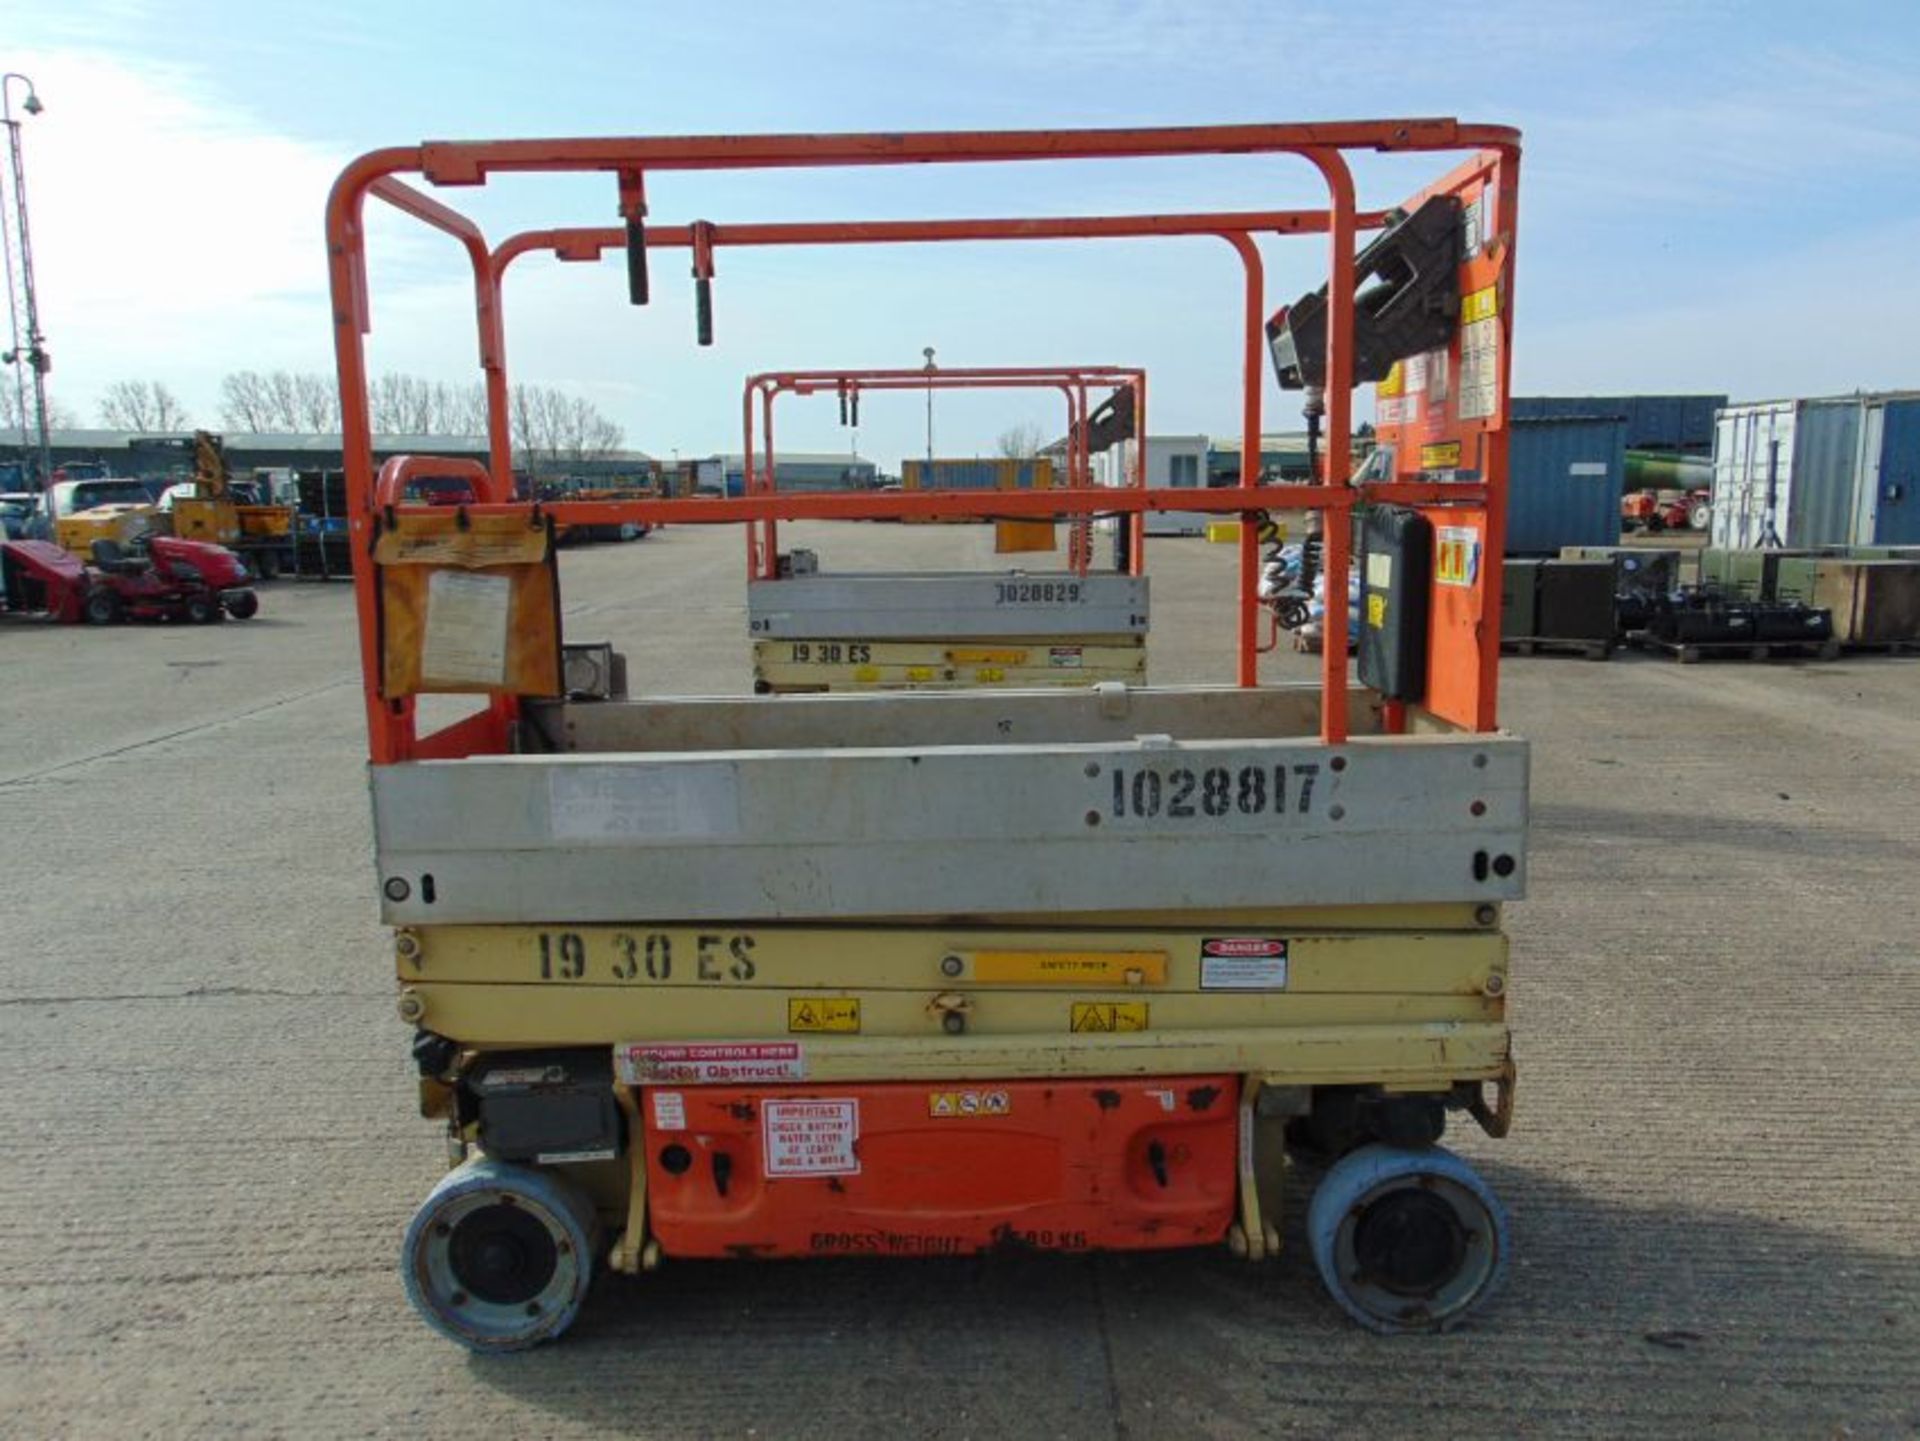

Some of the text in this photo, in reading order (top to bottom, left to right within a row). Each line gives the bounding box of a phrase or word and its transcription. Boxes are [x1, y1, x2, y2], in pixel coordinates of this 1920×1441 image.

[792, 644, 871, 663] 19 30 ES
[1112, 764, 1320, 818] 1028817
[539, 932, 756, 981] 19 30 ES
[706, 1062, 790, 1079] Obstruct!
